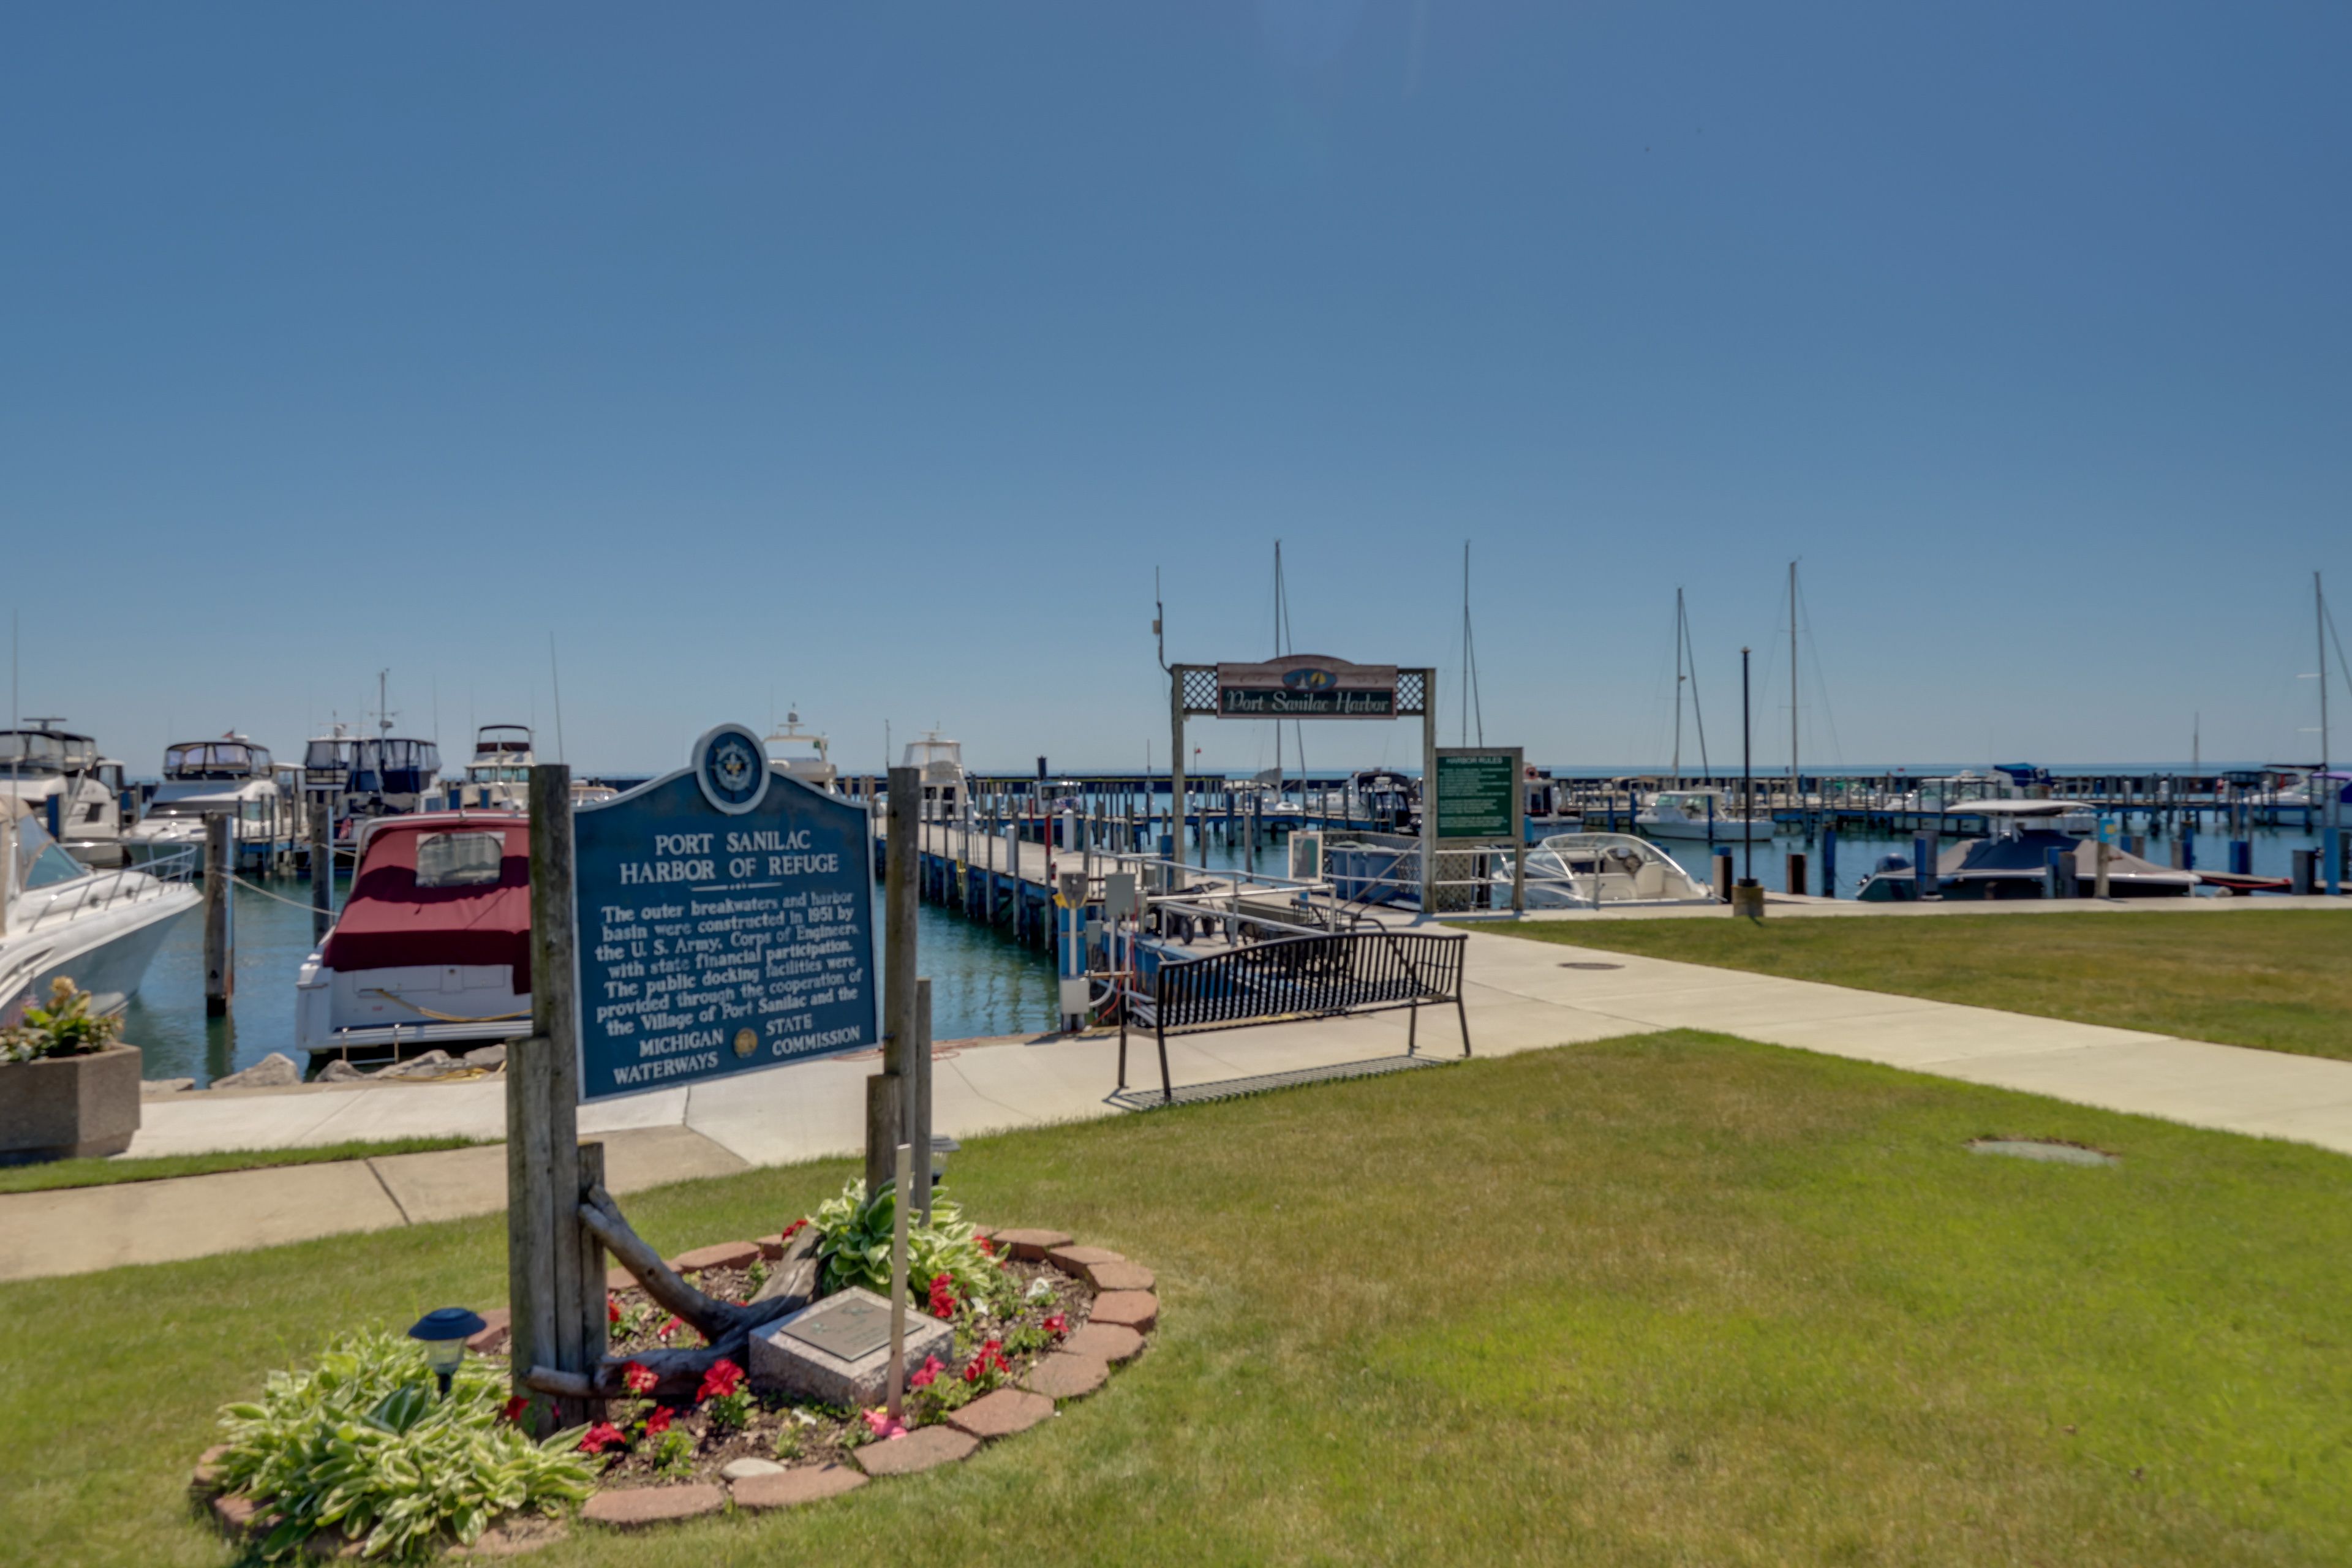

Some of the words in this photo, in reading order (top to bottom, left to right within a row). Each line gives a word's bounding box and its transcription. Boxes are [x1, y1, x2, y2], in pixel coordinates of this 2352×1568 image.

[1227, 690, 1264, 710] Port
[1272, 690, 1329, 712] Sanilac
[1336, 691, 1389, 714] Harbor
[655, 834, 714, 856] PORT
[726, 830, 811, 853] SANILAC
[620, 859, 716, 884] HARBOR
[729, 858, 756, 878] OF
[769, 853, 839, 875] REFUGE
[601, 905, 635, 923] The
[641, 903, 685, 920] outer
[690, 897, 778, 916] breakwaters
[783, 891, 807, 908] and
[810, 891, 854, 907] harbor
[601, 924, 648, 943] basin
[654, 922, 692, 937] were
[697, 910, 785, 933] constructed
[790, 910, 803, 925] in
[808, 906, 834, 923] 1951
[837, 905, 854, 922] by
[595, 944, 625, 962] the
[631, 941, 647, 957] U.
[653, 938, 669, 956] S.
[730, 930, 772, 949] Corps
[776, 925, 792, 943] of
[608, 960, 645, 979] with
[650, 958, 690, 974] state
[695, 951, 761, 970] financial
[766, 940, 853, 961] participation.
[597, 993, 669, 1023] provided
[676, 987, 734, 1008] through
[741, 984, 764, 998] the
[769, 973, 845, 994] cooperation
[849, 967, 863, 983] of
[603, 981, 638, 999] The
[646, 973, 696, 998] public
[702, 967, 760, 986] docking
[766, 959, 822, 978] facilities
[827, 956, 856, 970] were
[606, 1019, 635, 1036] the
[641, 1012, 693, 1030] Village
[699, 1005, 717, 1022] of
[722, 1000, 753, 1019] Port
[758, 994, 807, 1014] Sanilac
[810, 988, 834, 1006] and
[838, 986, 858, 1001] the
[639, 1028, 723, 1057] MICHIGAN
[766, 1013, 812, 1036] STATE
[613, 1051, 718, 1085] WATERWAYS
[772, 1025, 860, 1056] COMMISSION
